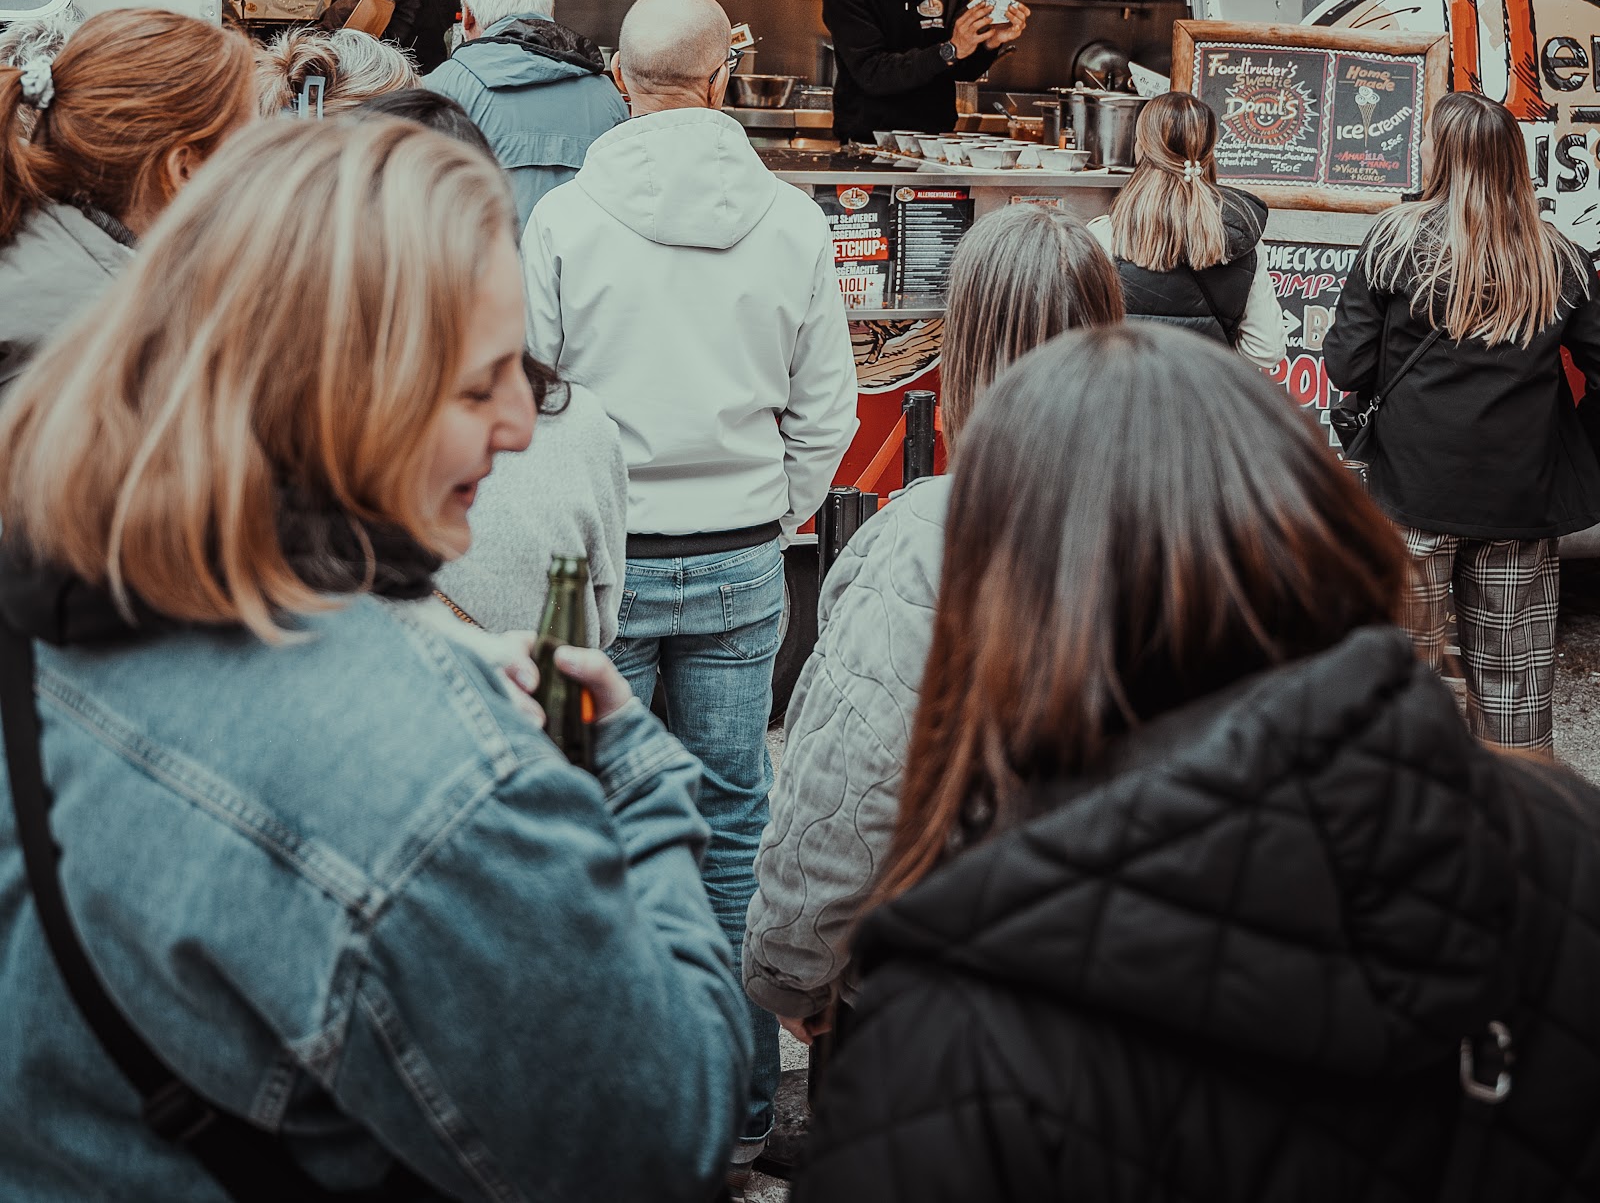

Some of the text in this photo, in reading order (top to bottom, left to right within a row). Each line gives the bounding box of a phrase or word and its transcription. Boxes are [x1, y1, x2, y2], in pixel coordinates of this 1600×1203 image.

[1208, 53, 1298, 78] Foodtrucker's
[1346, 66, 1391, 80] Home
[1354, 78, 1395, 92] made
[1221, 89, 1299, 120] Donuts
[833, 240, 880, 257] ETCHUP
[1320, 248, 1360, 273] OUT
